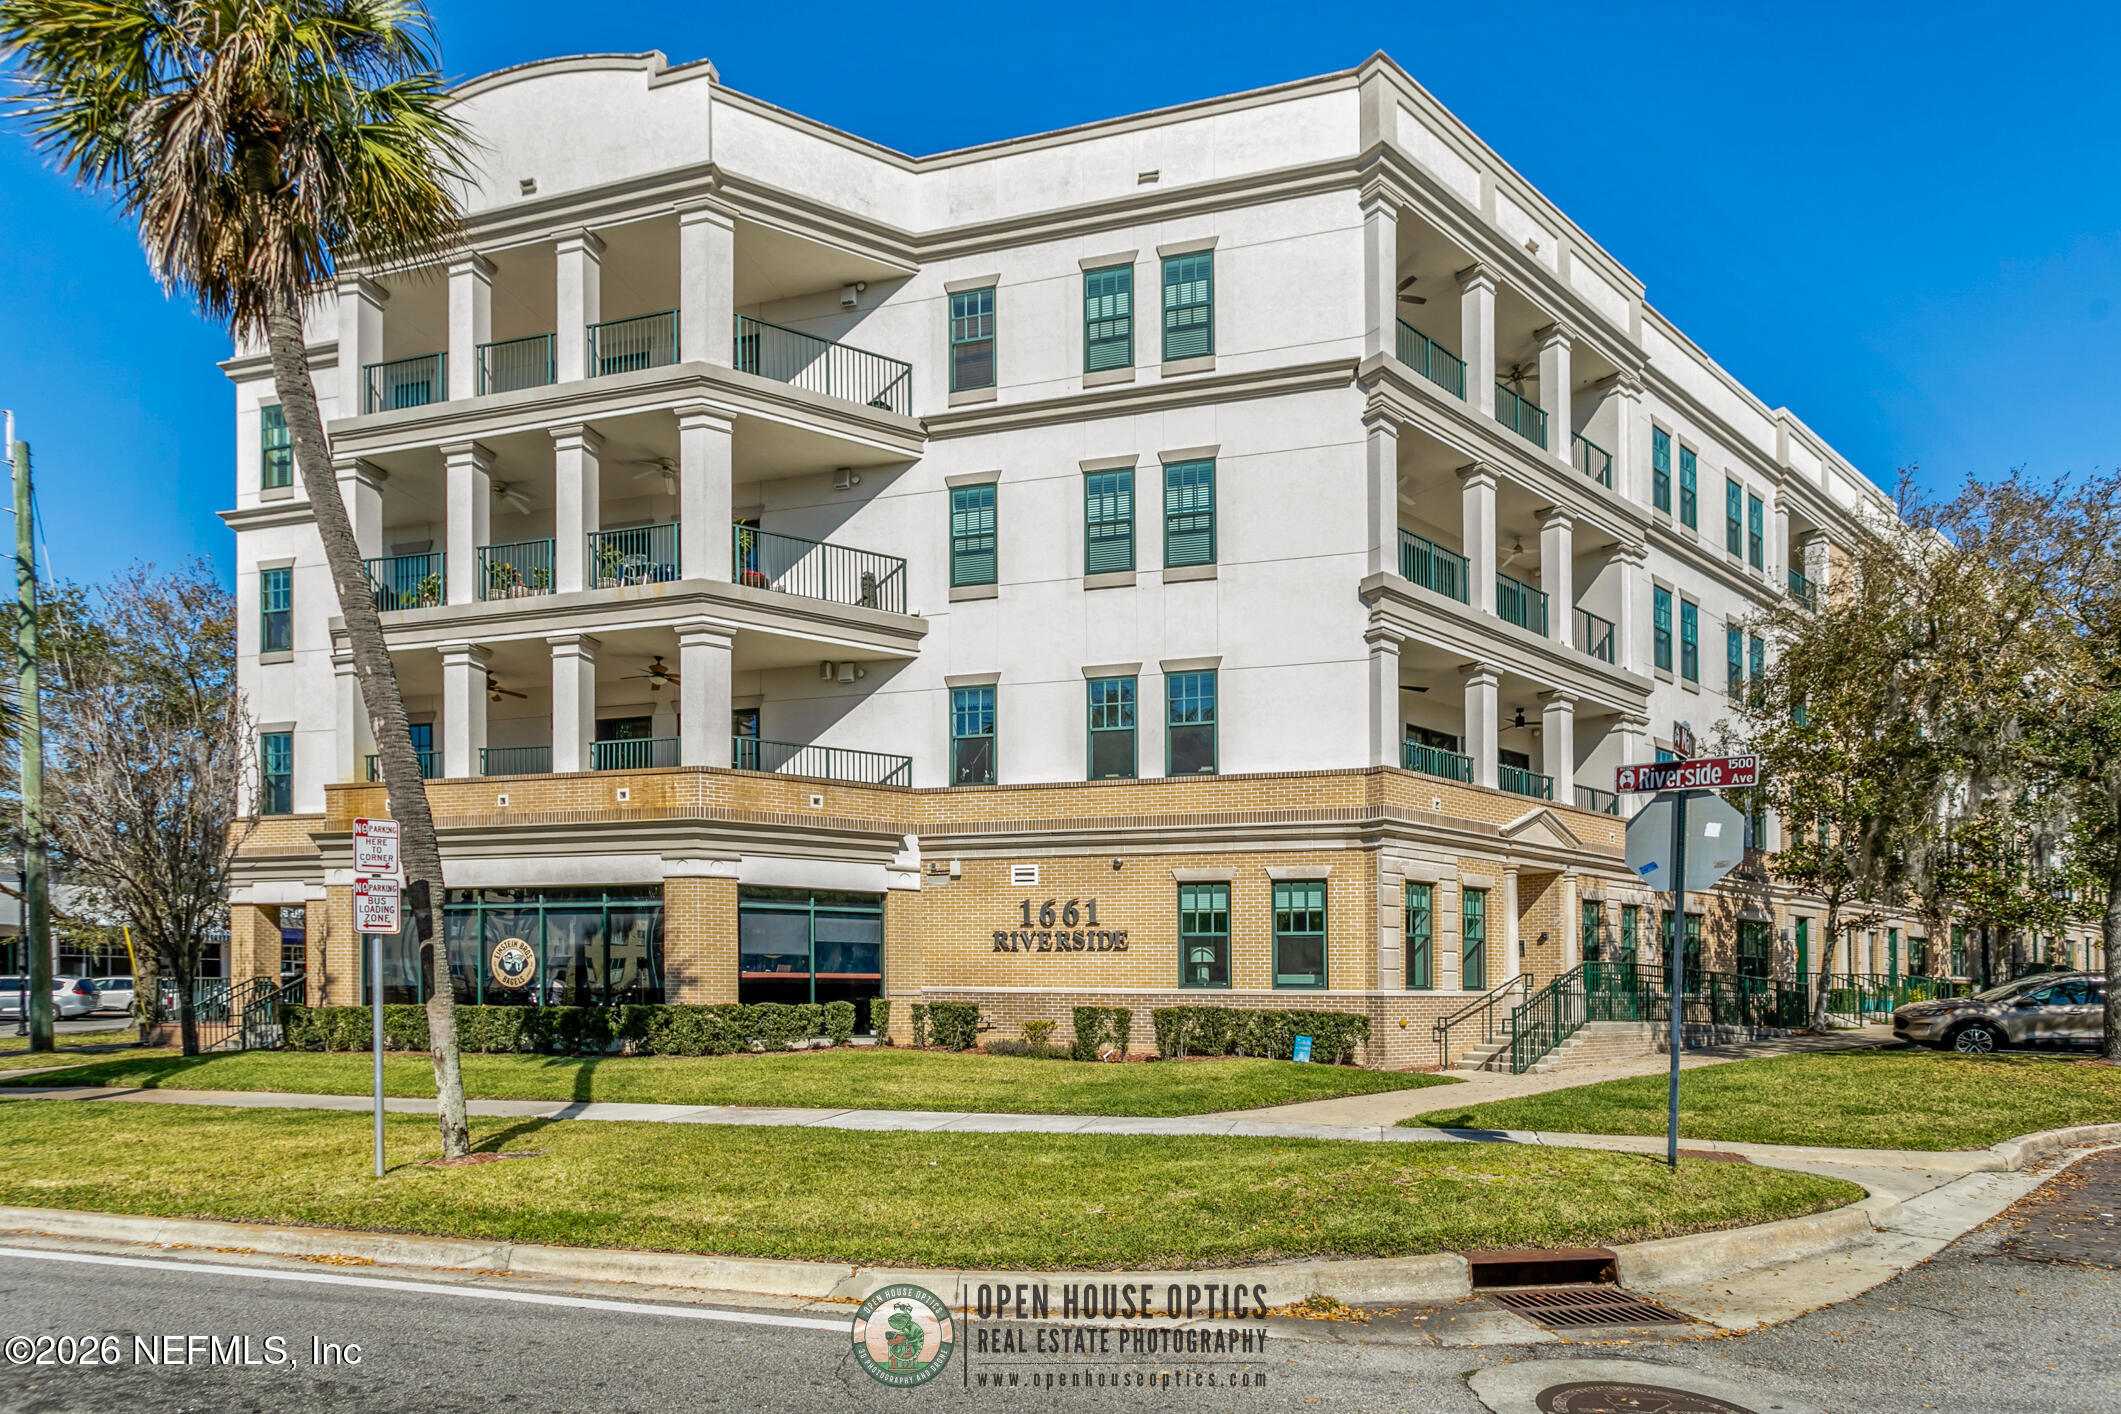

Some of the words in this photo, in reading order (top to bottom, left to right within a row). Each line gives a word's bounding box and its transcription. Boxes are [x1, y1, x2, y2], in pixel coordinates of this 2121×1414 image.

[1728, 757, 1754, 769] 1500
[1639, 763, 1723, 790] Riverside
[1731, 773, 1754, 784] Ave
[355, 823, 368, 834] NO
[368, 824, 397, 835] PARKING
[365, 838, 388, 846] HERE
[372, 846, 382, 854] TO
[360, 853, 394, 862] CORNER
[355, 882, 368, 893] NO
[368, 884, 397, 893] PARKING
[368, 897, 387, 905] BUS
[359, 905, 395, 914] LOADING
[1020, 898, 1100, 929] 1661
[364, 914, 390, 922] ZONE
[992, 930, 1130, 952] RIVERSIDE
[494, 940, 518, 959] EINSTEIN
[519, 942, 533, 960] BROS
[502, 975, 525, 986] BAGELS
